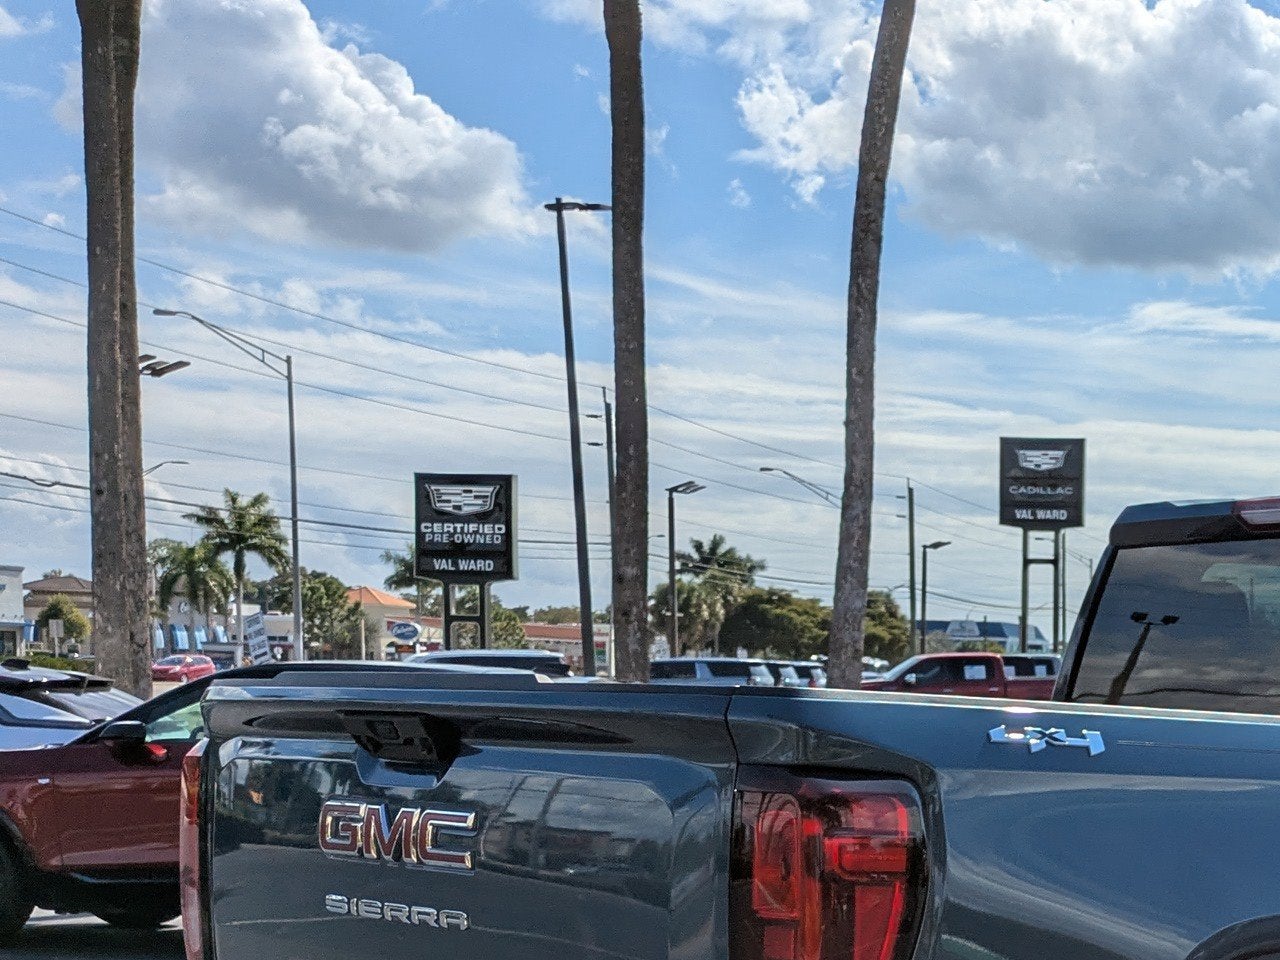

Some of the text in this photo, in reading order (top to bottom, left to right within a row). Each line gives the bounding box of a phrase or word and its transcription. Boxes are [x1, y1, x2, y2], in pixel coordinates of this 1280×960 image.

[1009, 485, 1074, 495] CADILLAC
[1014, 509, 1068, 520] VAL WARD
[420, 522, 506, 534] CERTIFIED
[425, 533, 502, 544] PRE-OWNED
[433, 558, 495, 572] VAL WARD
[319, 799, 477, 870] GMC
[325, 893, 469, 931] SIERRA
